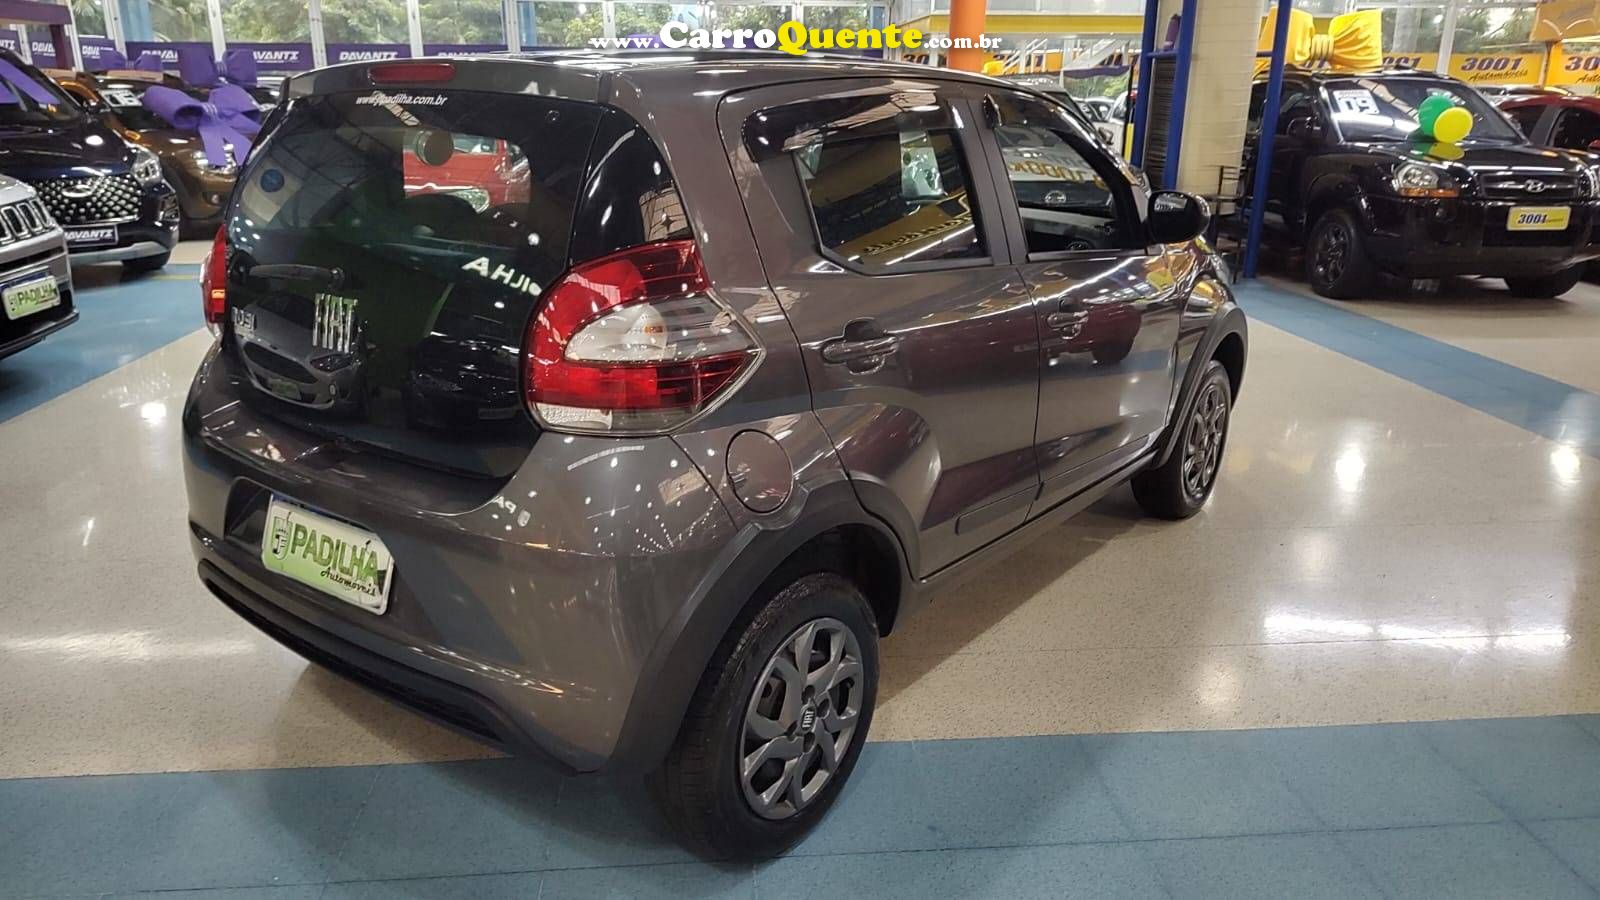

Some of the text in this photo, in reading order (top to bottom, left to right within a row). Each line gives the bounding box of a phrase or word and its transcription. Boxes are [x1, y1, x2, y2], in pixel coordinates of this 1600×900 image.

[253, 51, 299, 60] VANTI
[1461, 56, 1523, 71] 3001
[1564, 56, 1600, 71] 30
[1517, 214, 1548, 225] 3001
[17, 283, 57, 305] PADILHA
[312, 292, 358, 353] FIAT
[290, 523, 380, 586] PADILHA
[802, 710, 815, 728] FIAT
